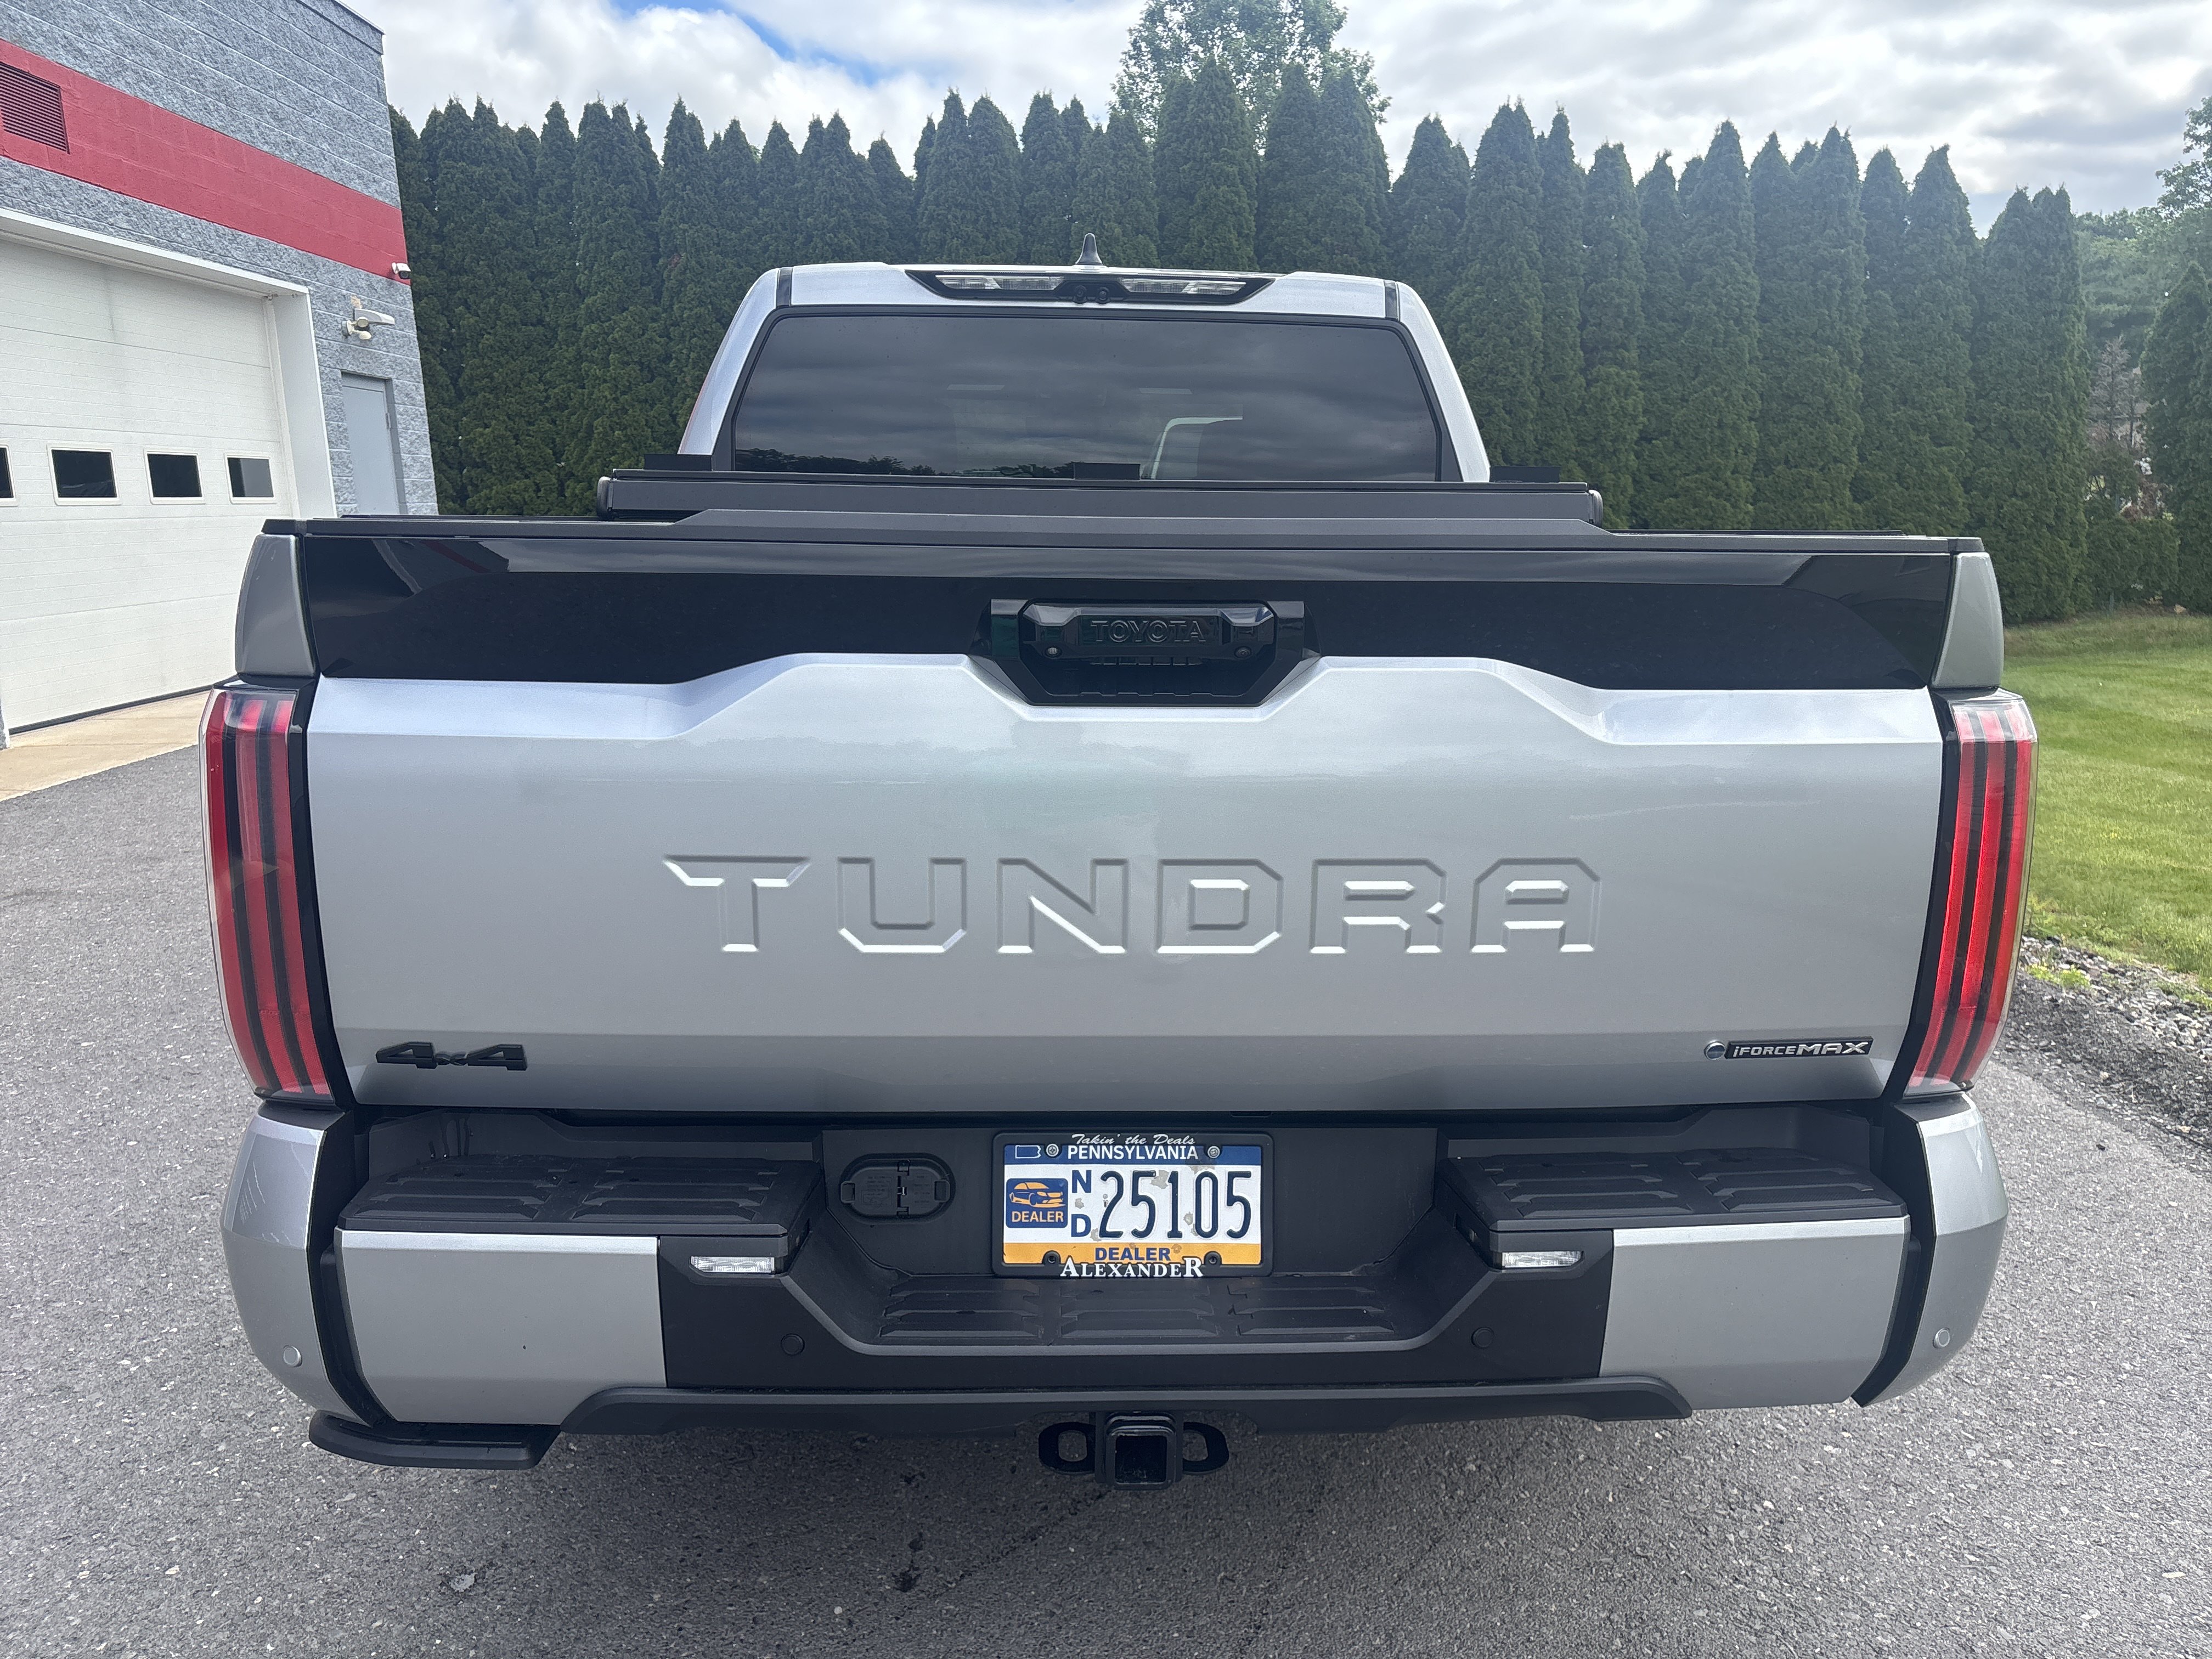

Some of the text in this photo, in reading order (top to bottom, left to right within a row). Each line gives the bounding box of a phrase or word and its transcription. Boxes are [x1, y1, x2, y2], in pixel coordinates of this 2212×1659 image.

[1090, 620, 1206, 642] TOYOTA
[663, 854, 1600, 955] TUNDRA
[1071, 1133, 1196, 1145] Takin' the Deals
[1068, 1145, 1199, 1160] PENNSYLVANIA
[1099, 1171, 1252, 1239] 25105
[1012, 1211, 1064, 1223] DEALER
[1094, 1247, 1171, 1261] DEALER
[1060, 1256, 1204, 1277] ALEXANDER
